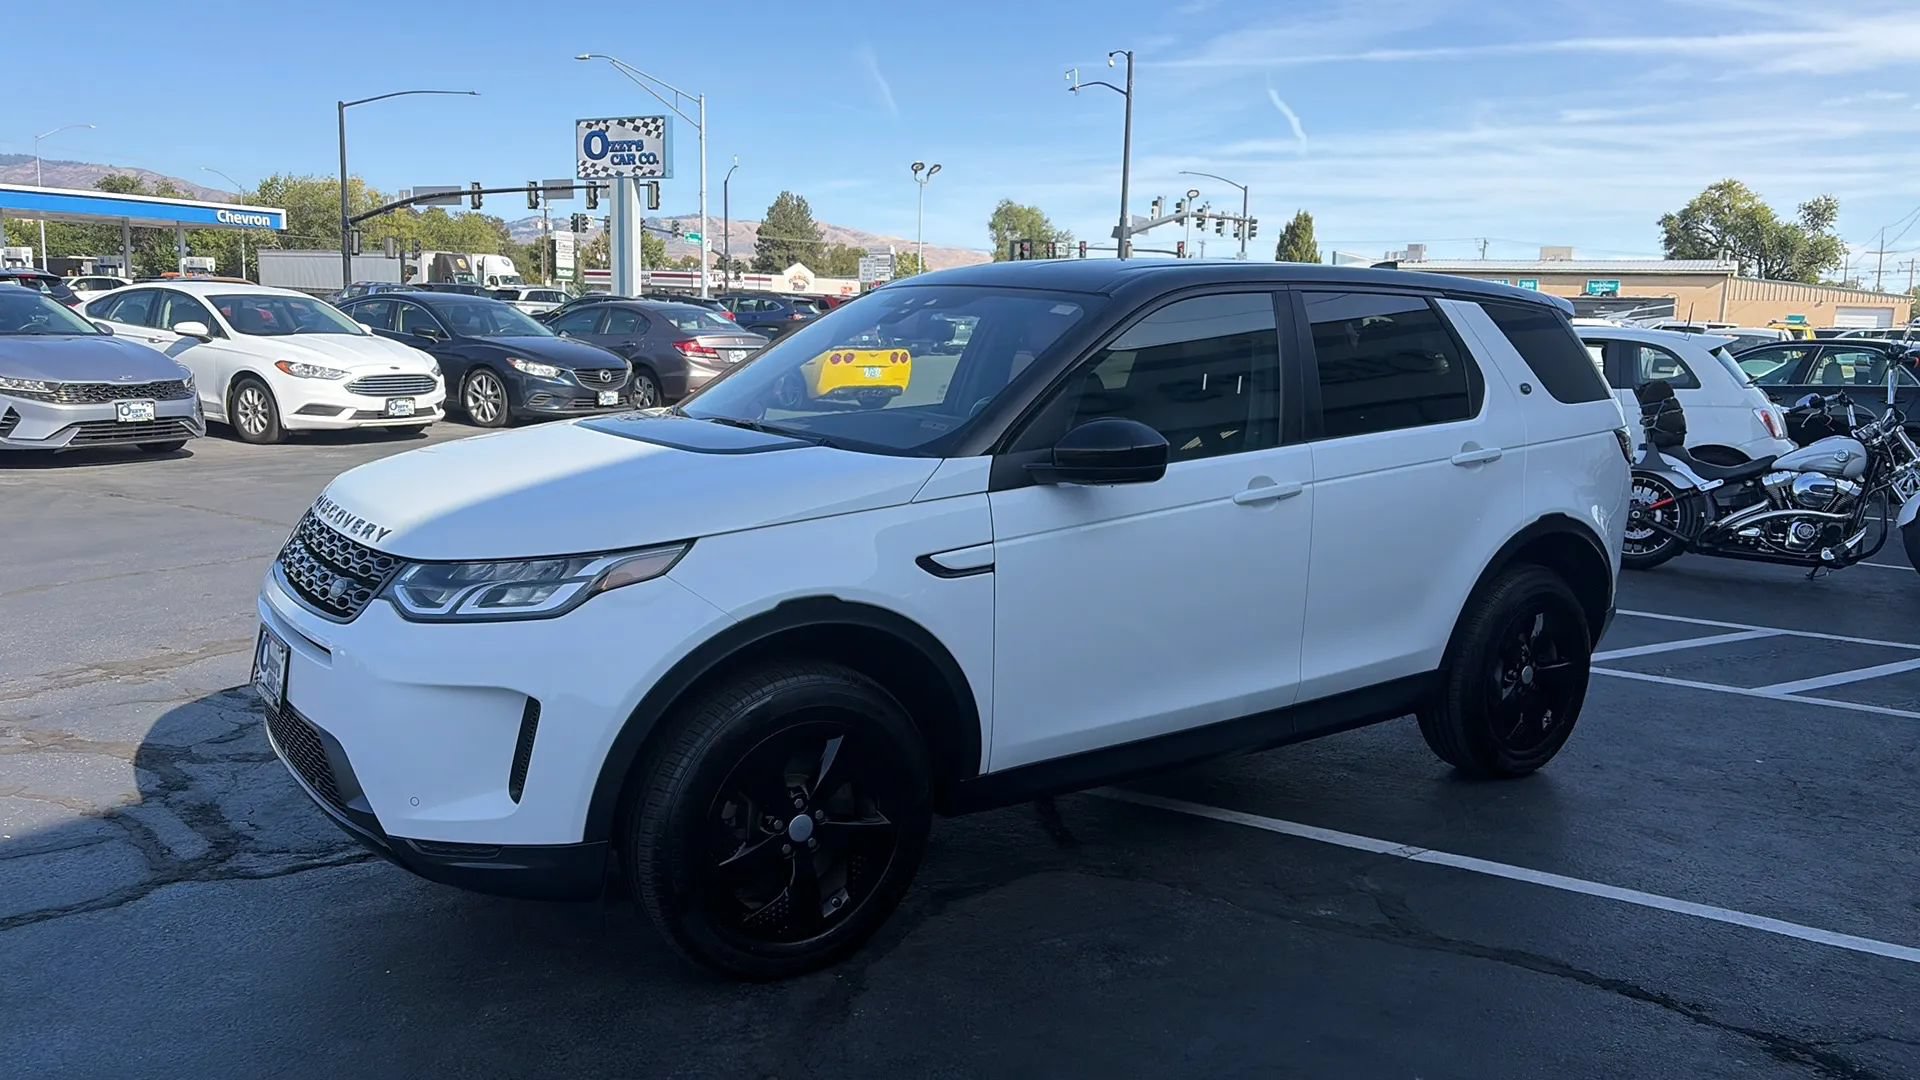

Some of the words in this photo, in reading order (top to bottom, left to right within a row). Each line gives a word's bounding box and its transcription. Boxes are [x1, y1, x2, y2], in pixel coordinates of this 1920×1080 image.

[583, 130, 644, 160] OZZY'S
[610, 153, 636, 165] CAR
[638, 152, 659, 165] CO.
[216, 209, 271, 226] Chevron
[316, 494, 393, 543] DISCOVERY
